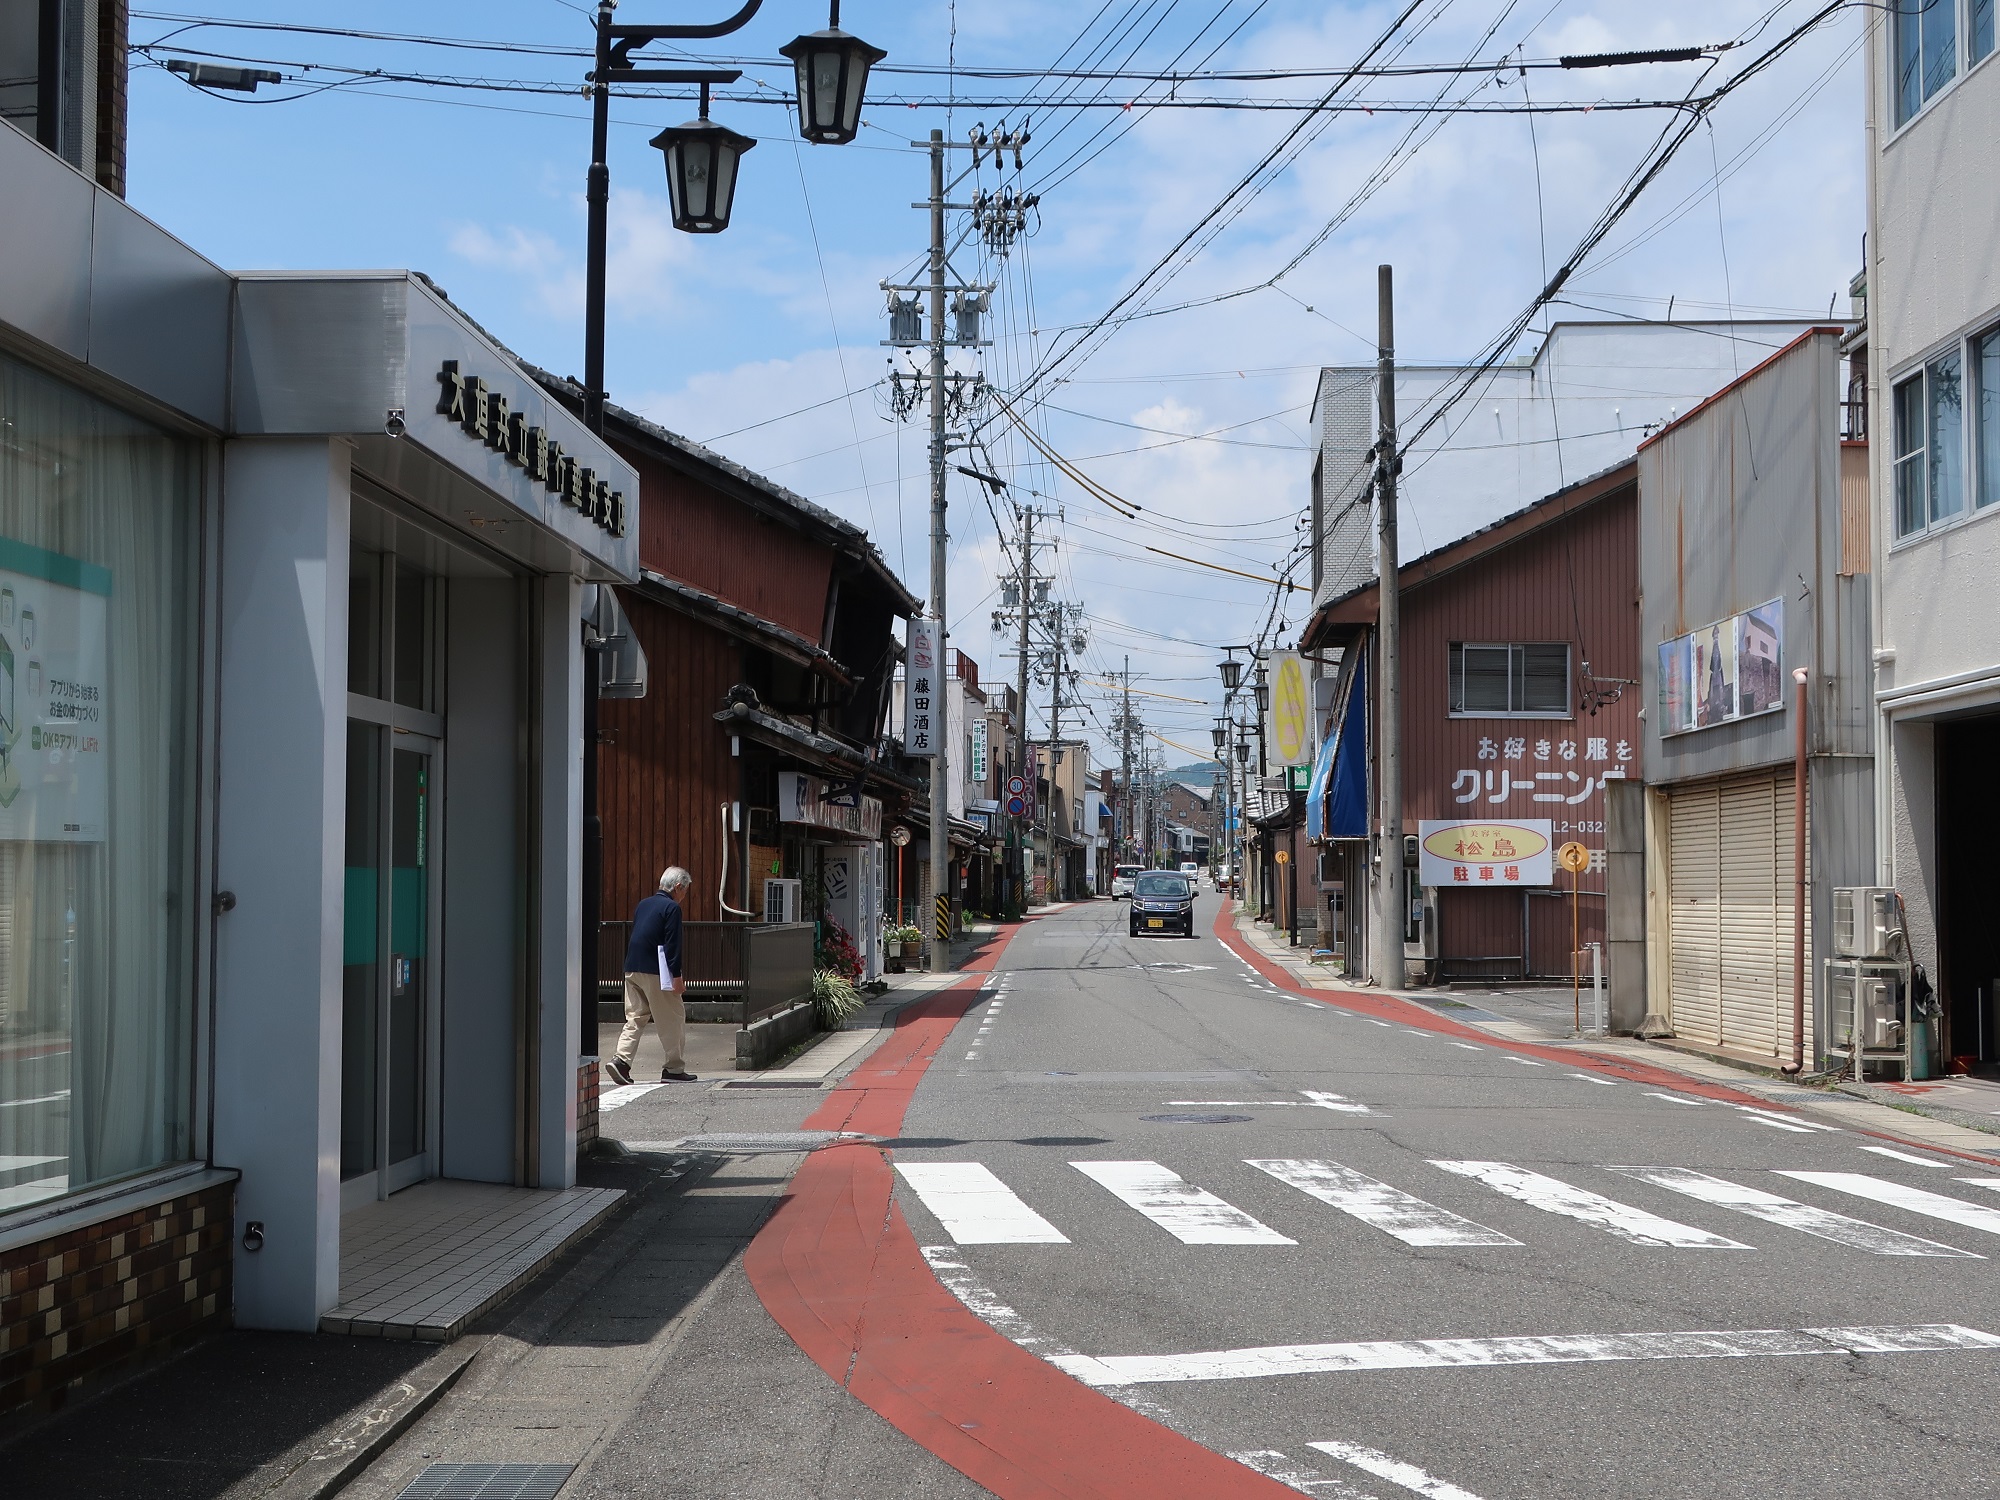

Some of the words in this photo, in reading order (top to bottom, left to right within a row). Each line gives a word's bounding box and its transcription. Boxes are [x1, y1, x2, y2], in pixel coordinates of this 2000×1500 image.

[438, 360, 625, 537] 大垣共立銀行垂井支店
[50, 680, 99, 701] アプリから始まる
[50, 701, 99, 722] お金の体力づくり
[913, 678, 931, 749] 藤田酒店
[1478, 737, 1633, 761] お好きな服を
[1011, 781, 1022, 791] 30
[1454, 838, 1517, 858] 松島
[1453, 865, 1520, 882] 駐車場
